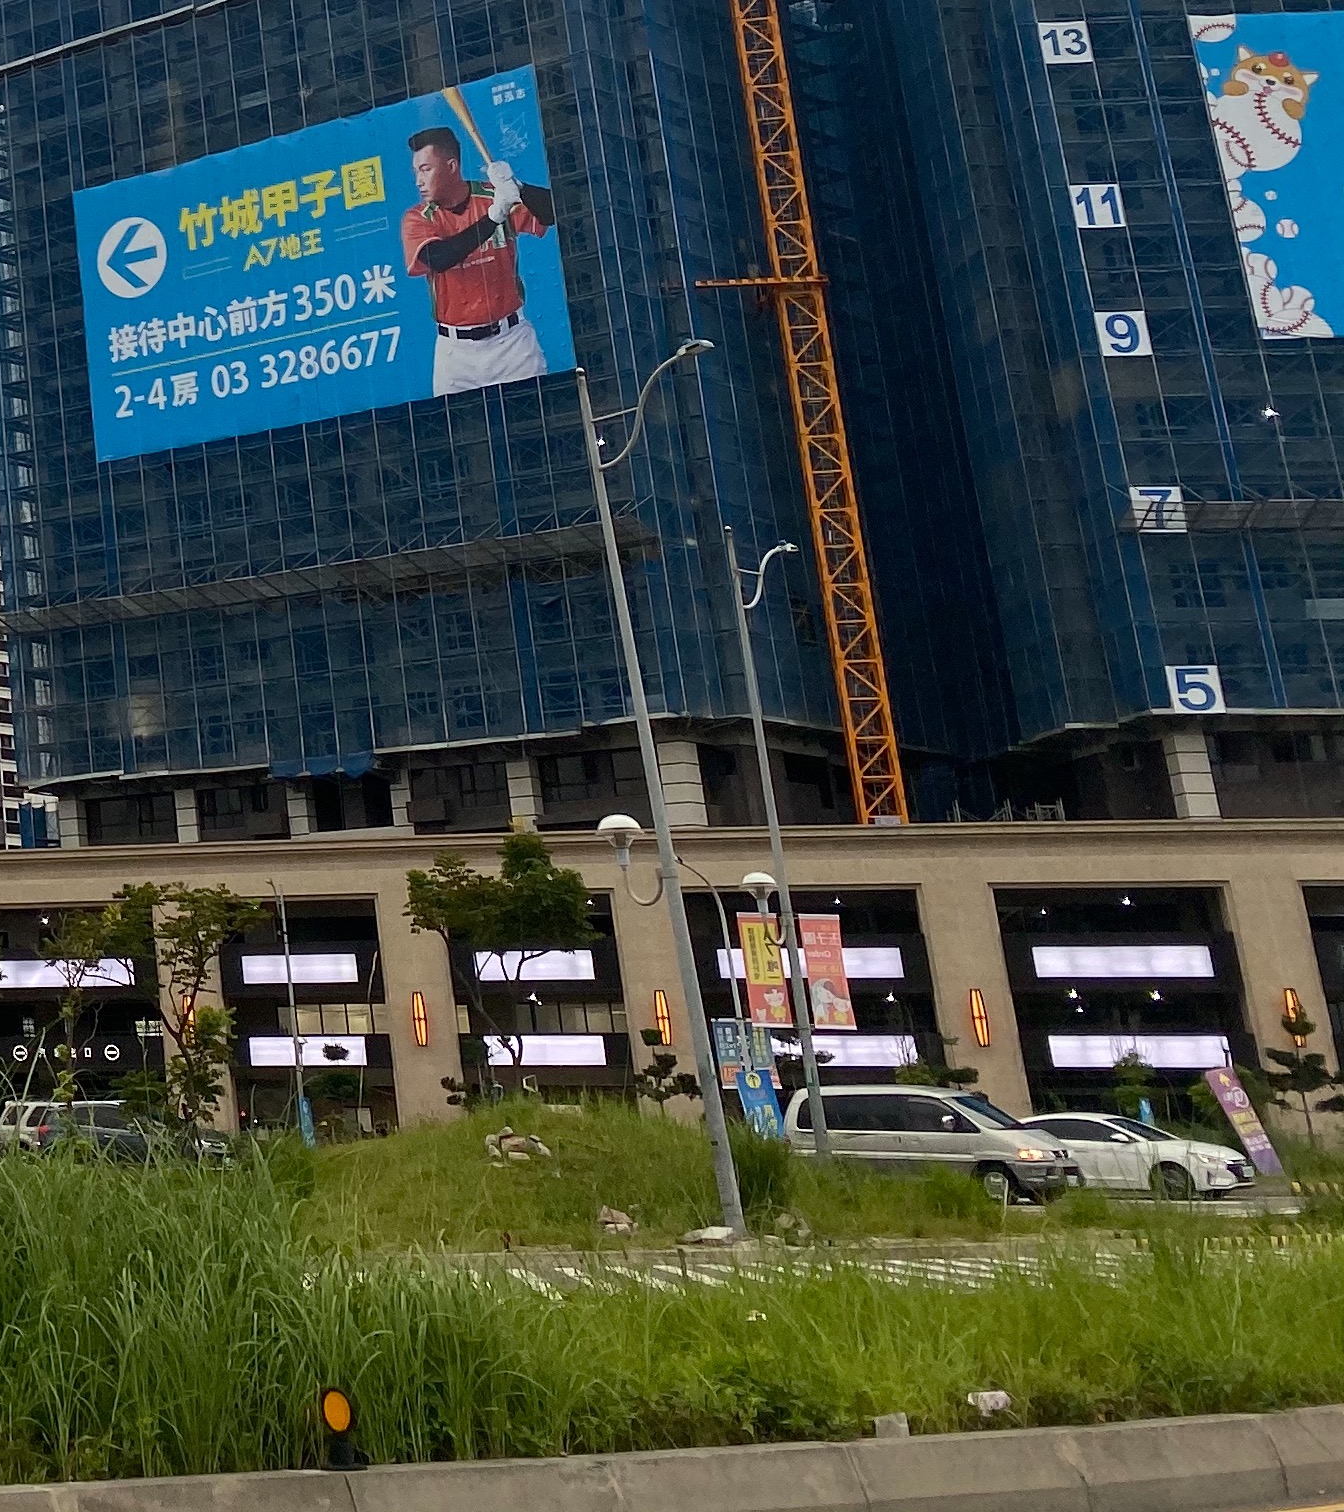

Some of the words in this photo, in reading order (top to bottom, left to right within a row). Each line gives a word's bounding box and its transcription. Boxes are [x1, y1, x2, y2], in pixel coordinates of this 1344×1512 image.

[1042, 28, 1088, 57] 13
[179, 155, 386, 251] 竹城甲子園
[1074, 186, 1123, 226] 11
[243, 229, 325, 273] A7地王
[1104, 313, 1141, 354] 9
[114, 369, 199, 419] 2-4房
[212, 359, 249, 399] 03
[261, 325, 403, 390] 3286677
[1138, 489, 1173, 530] 7
[1175, 668, 1217, 711] 5
